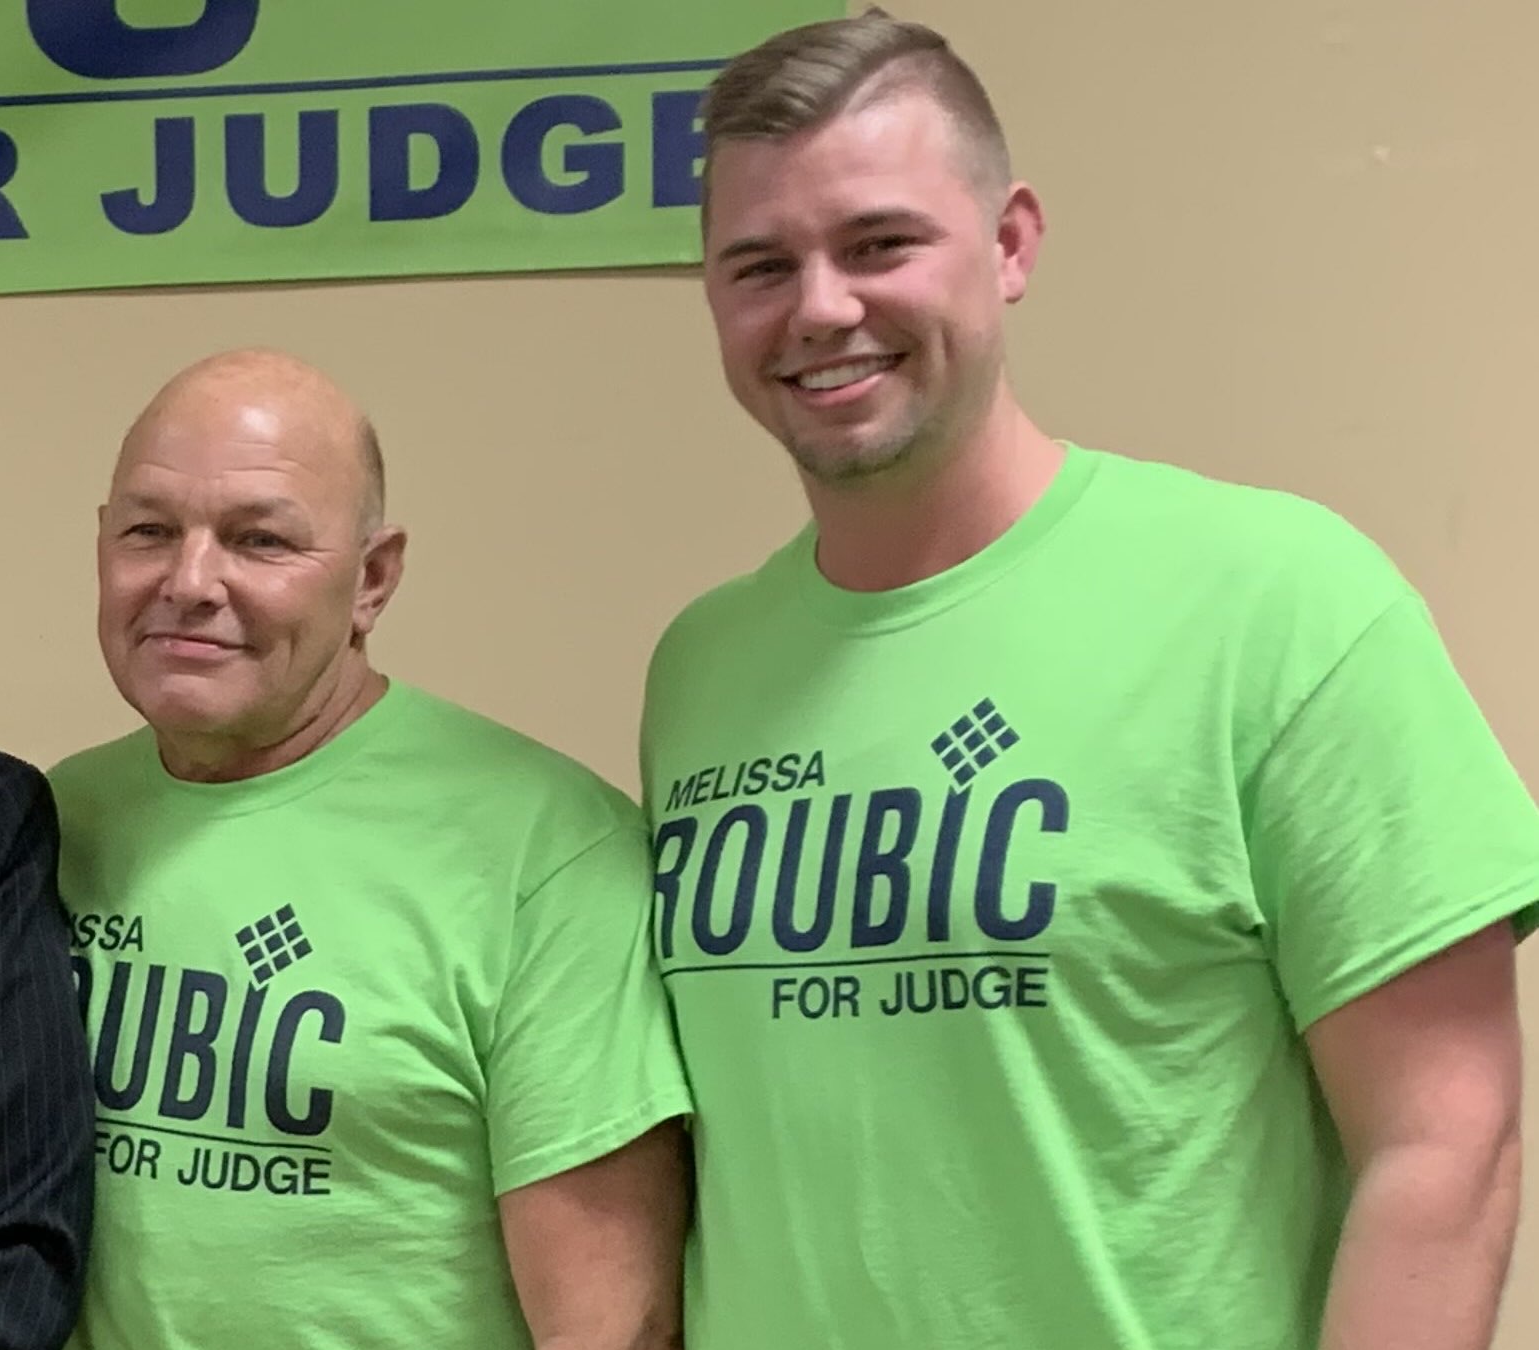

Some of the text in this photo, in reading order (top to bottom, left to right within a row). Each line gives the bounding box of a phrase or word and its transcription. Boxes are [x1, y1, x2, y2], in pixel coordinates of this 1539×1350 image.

[100, 90, 709, 236] JUDGE
[665, 750, 825, 813] MELISSA
[654, 778, 1070, 959] ROUBIC
[772, 966, 1049, 1019] FOR JUDGE
[178, 1148, 332, 1195] JUDGE
